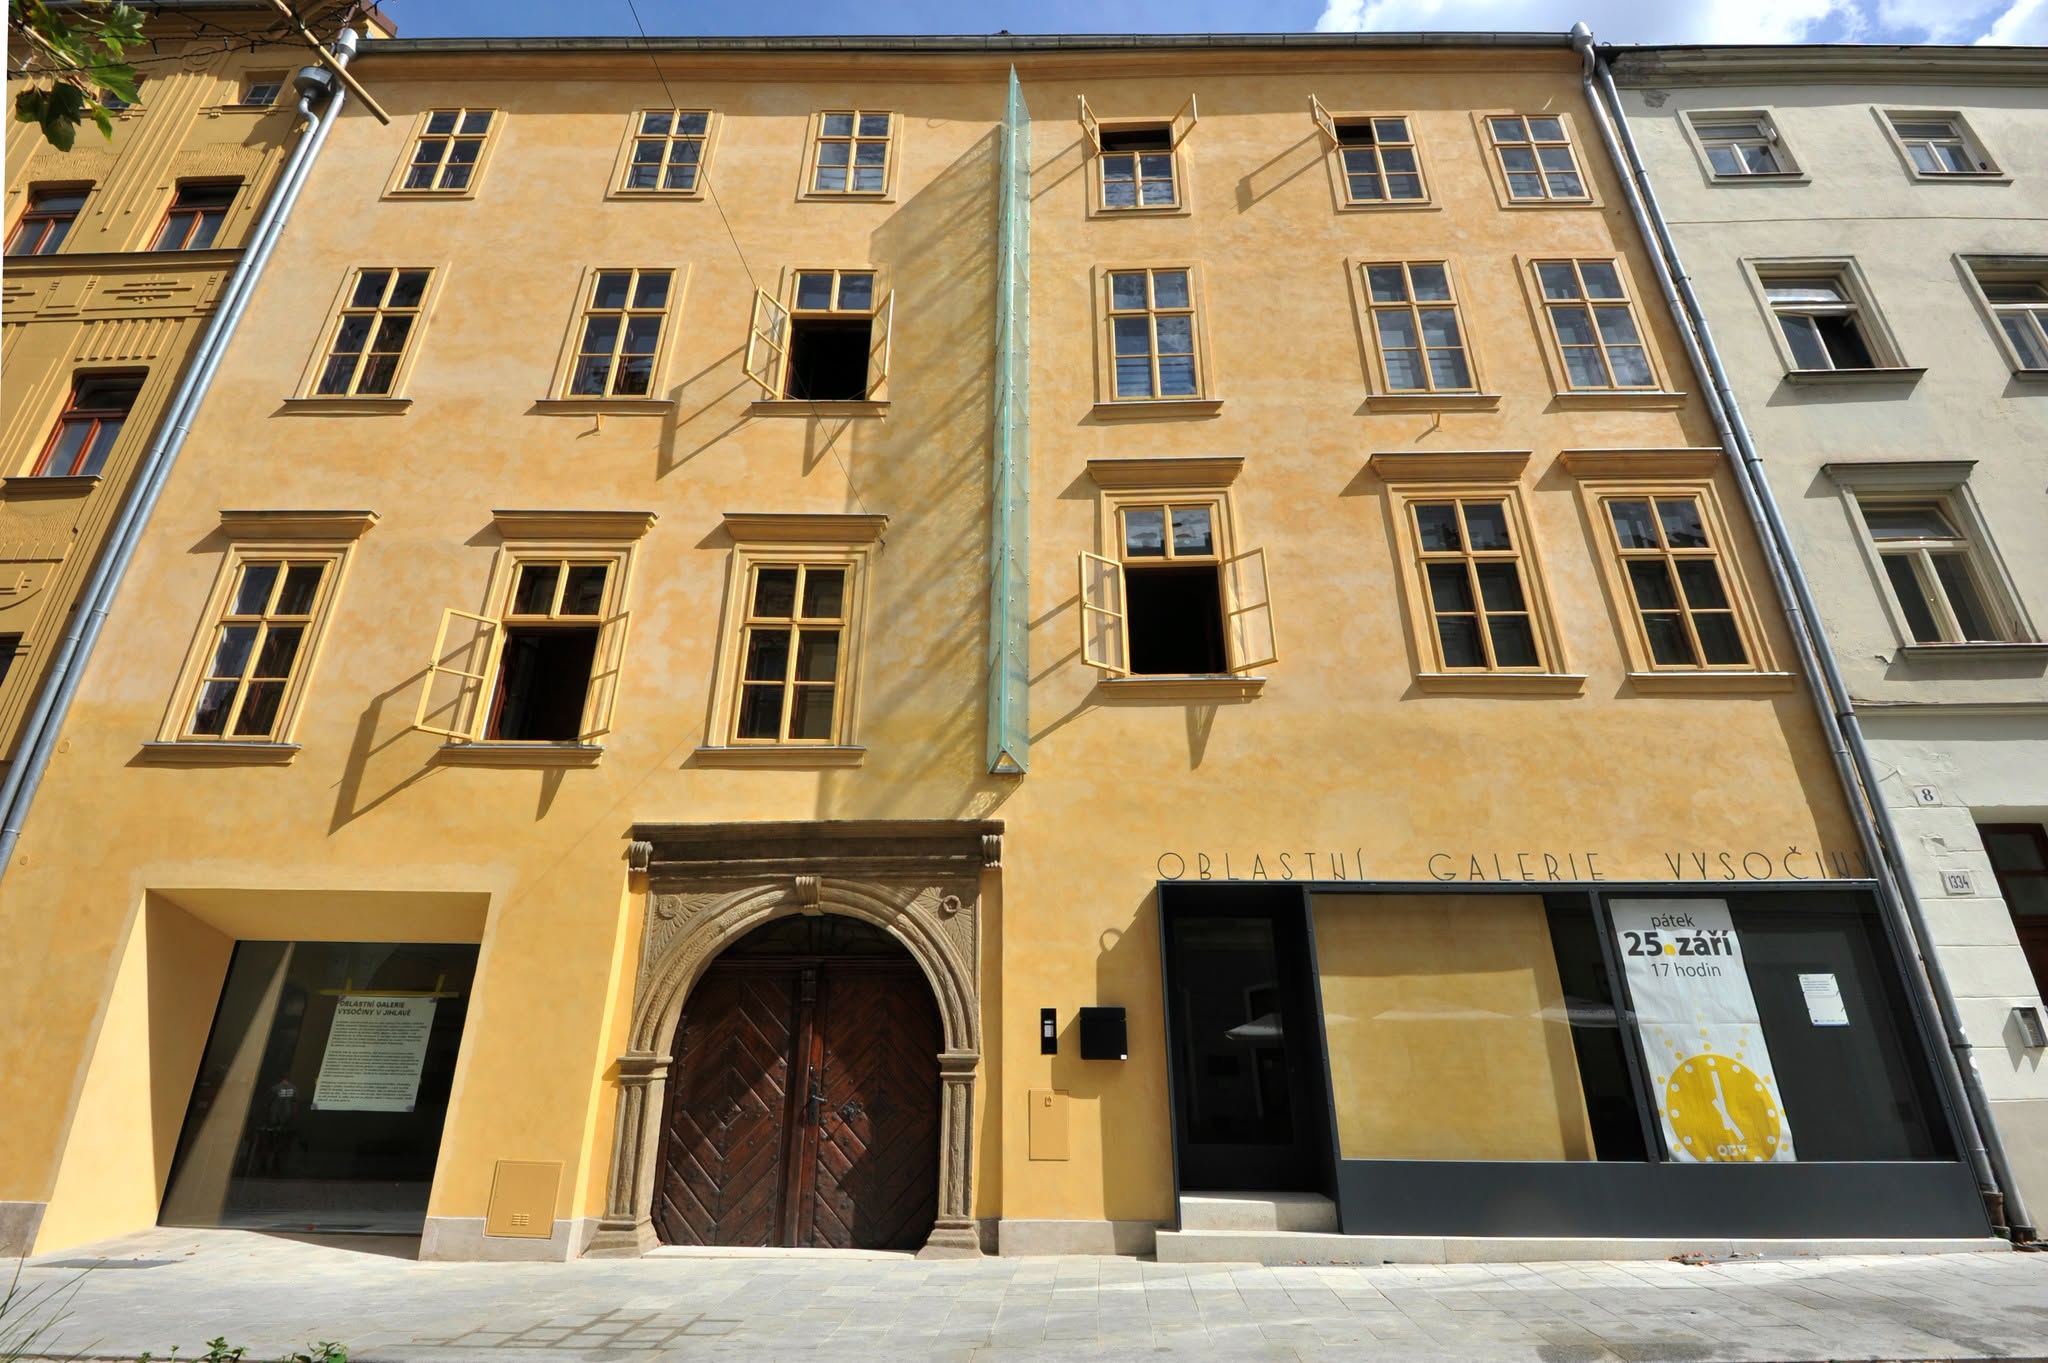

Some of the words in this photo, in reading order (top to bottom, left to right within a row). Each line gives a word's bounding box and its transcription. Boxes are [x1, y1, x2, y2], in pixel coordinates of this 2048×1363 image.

[1921, 788, 1934, 802] 8
[1157, 847, 1364, 881] OBLASTNÍ
[1428, 853, 1605, 881] GALERIE
[1948, 875, 1970, 889] 1334
[1650, 913, 1695, 928] pátek
[1651, 963, 1669, 977] 17
[1674, 961, 1722, 977] hodin
[340, 1000, 375, 1008] OBLASTNÍ
[376, 1001, 405, 1009] GALERIE
[338, 1008, 374, 1016] VYSOČINY
